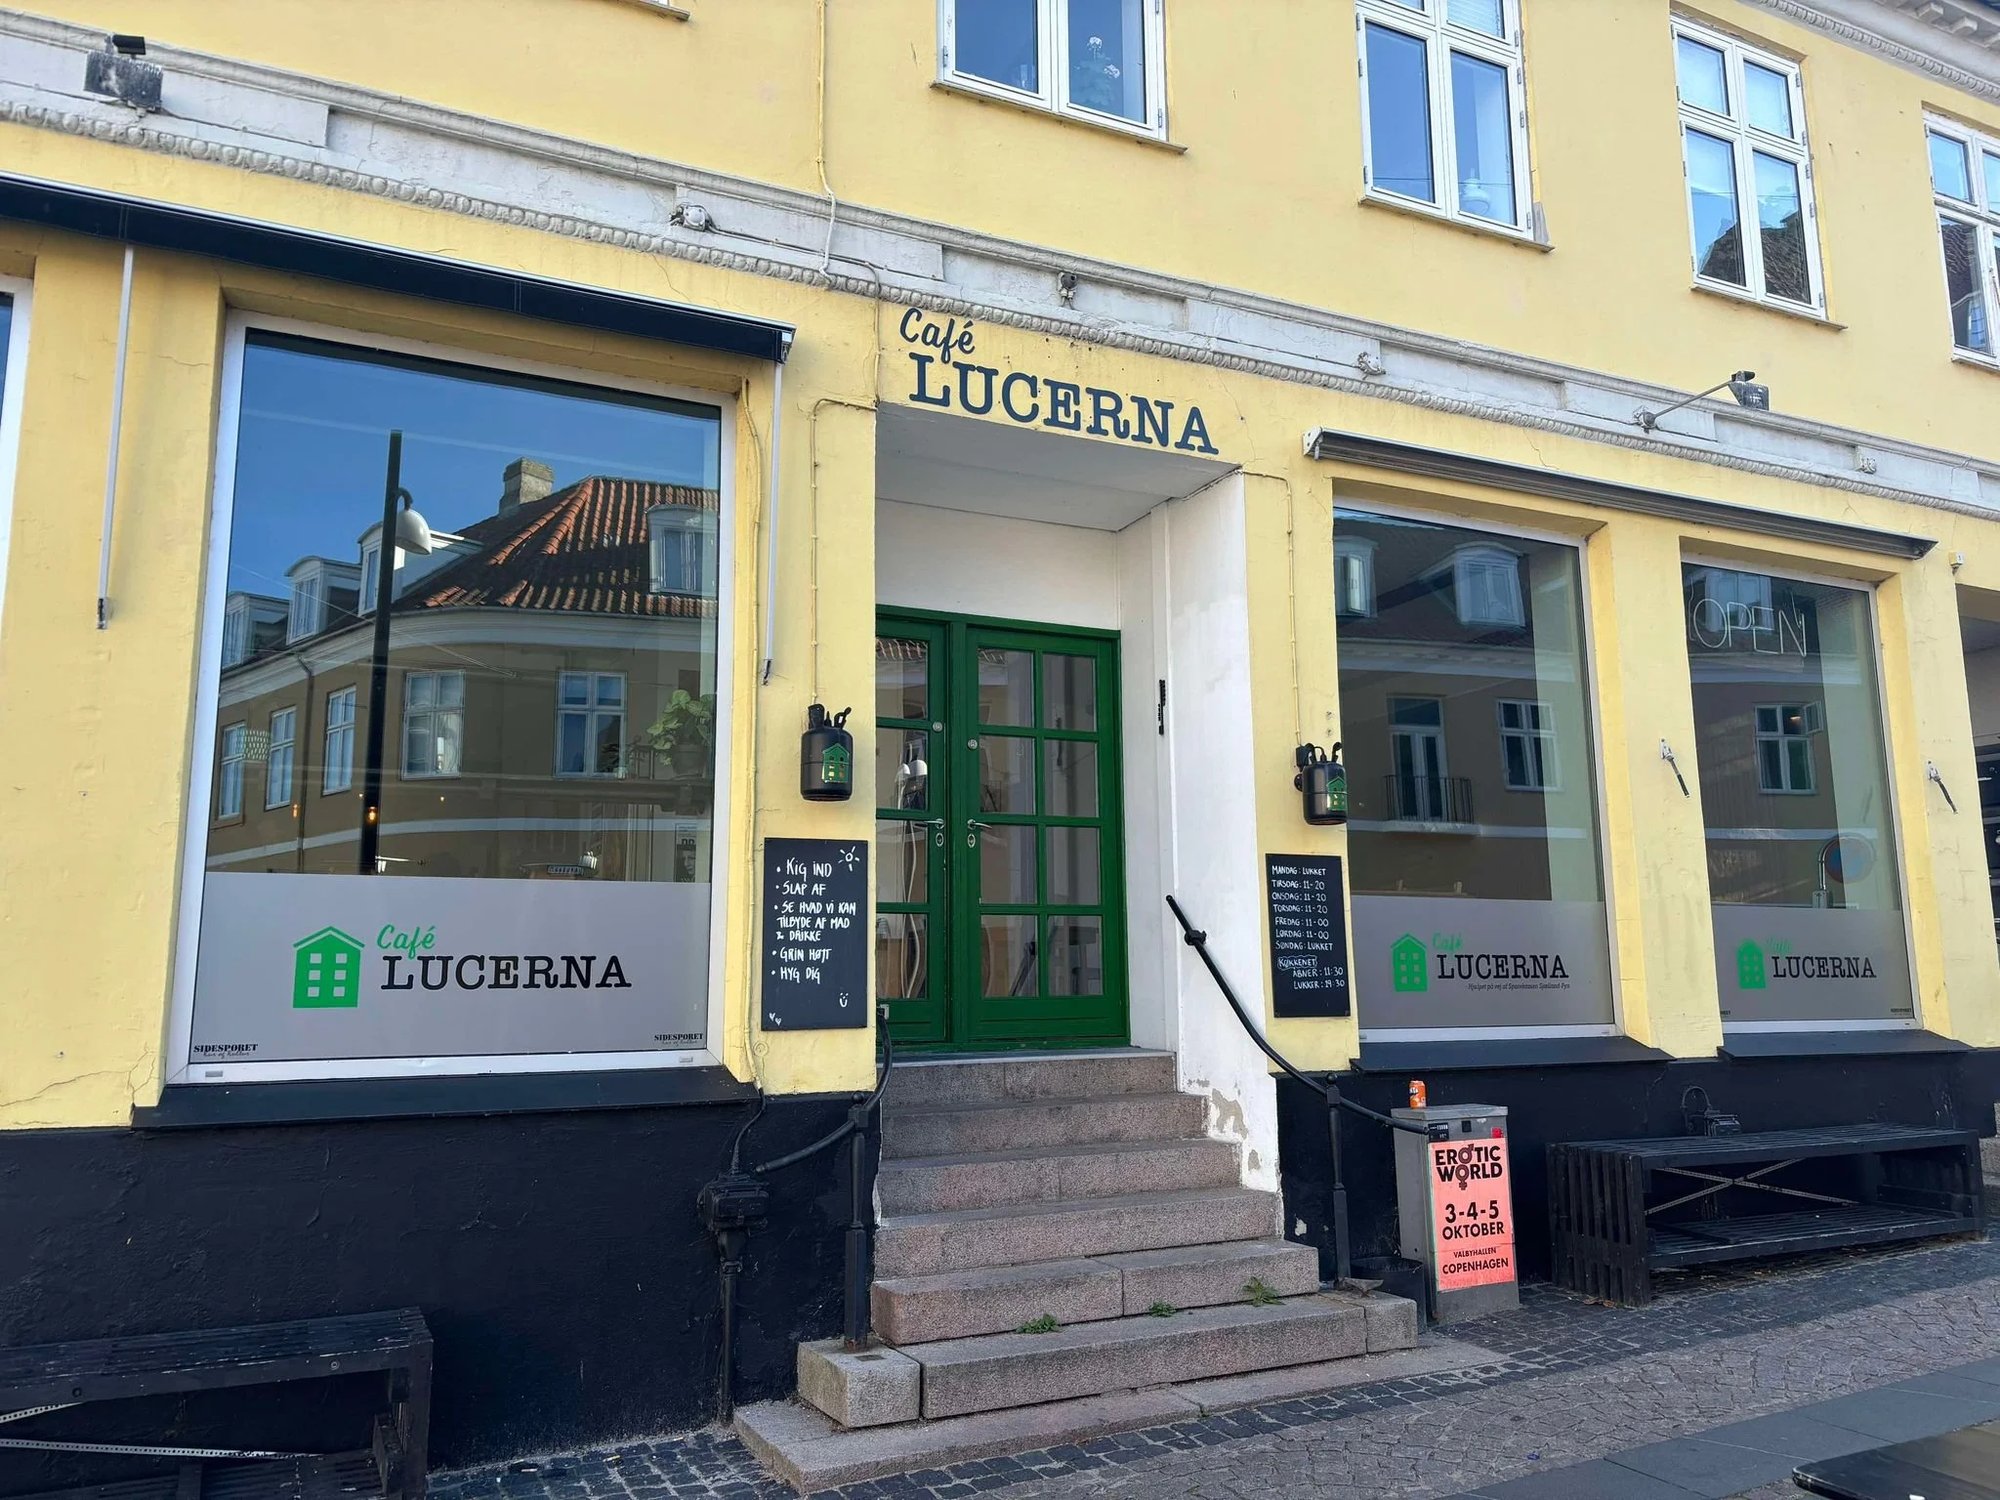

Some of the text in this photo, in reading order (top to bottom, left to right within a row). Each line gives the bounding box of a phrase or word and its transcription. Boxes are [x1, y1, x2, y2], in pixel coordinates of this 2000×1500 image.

[900, 308, 975, 364] Café
[909, 352, 1219, 455] LUCERNA
[1693, 598, 1807, 657] OPEN
[1302, 867, 1326, 875] LUKKET
[782, 881, 826, 896] SLAP AF
[781, 902, 794, 913] SE
[799, 902, 822, 914] HVAD
[838, 902, 857, 915] KAN
[815, 917, 827, 929] AF
[830, 917, 850, 929] MAD
[376, 924, 436, 959] Café
[1307, 941, 1333, 951] LUKKET
[380, 955, 632, 990] LUCERNA
[780, 966, 800, 984] HYG
[1436, 954, 1569, 980] LUCERNA
[1772, 956, 1877, 978] LUCERNA
[193, 1043, 258, 1053] SIDESPORET
[1435, 1144, 1501, 1166] EROTIC
[1437, 1163, 1503, 1190] WORLD
[1443, 1222, 1504, 1239] OKTOBER
[1453, 1247, 1497, 1258] VALBYHALLEN
[1442, 1258, 1509, 1274] COPENHAGEN
